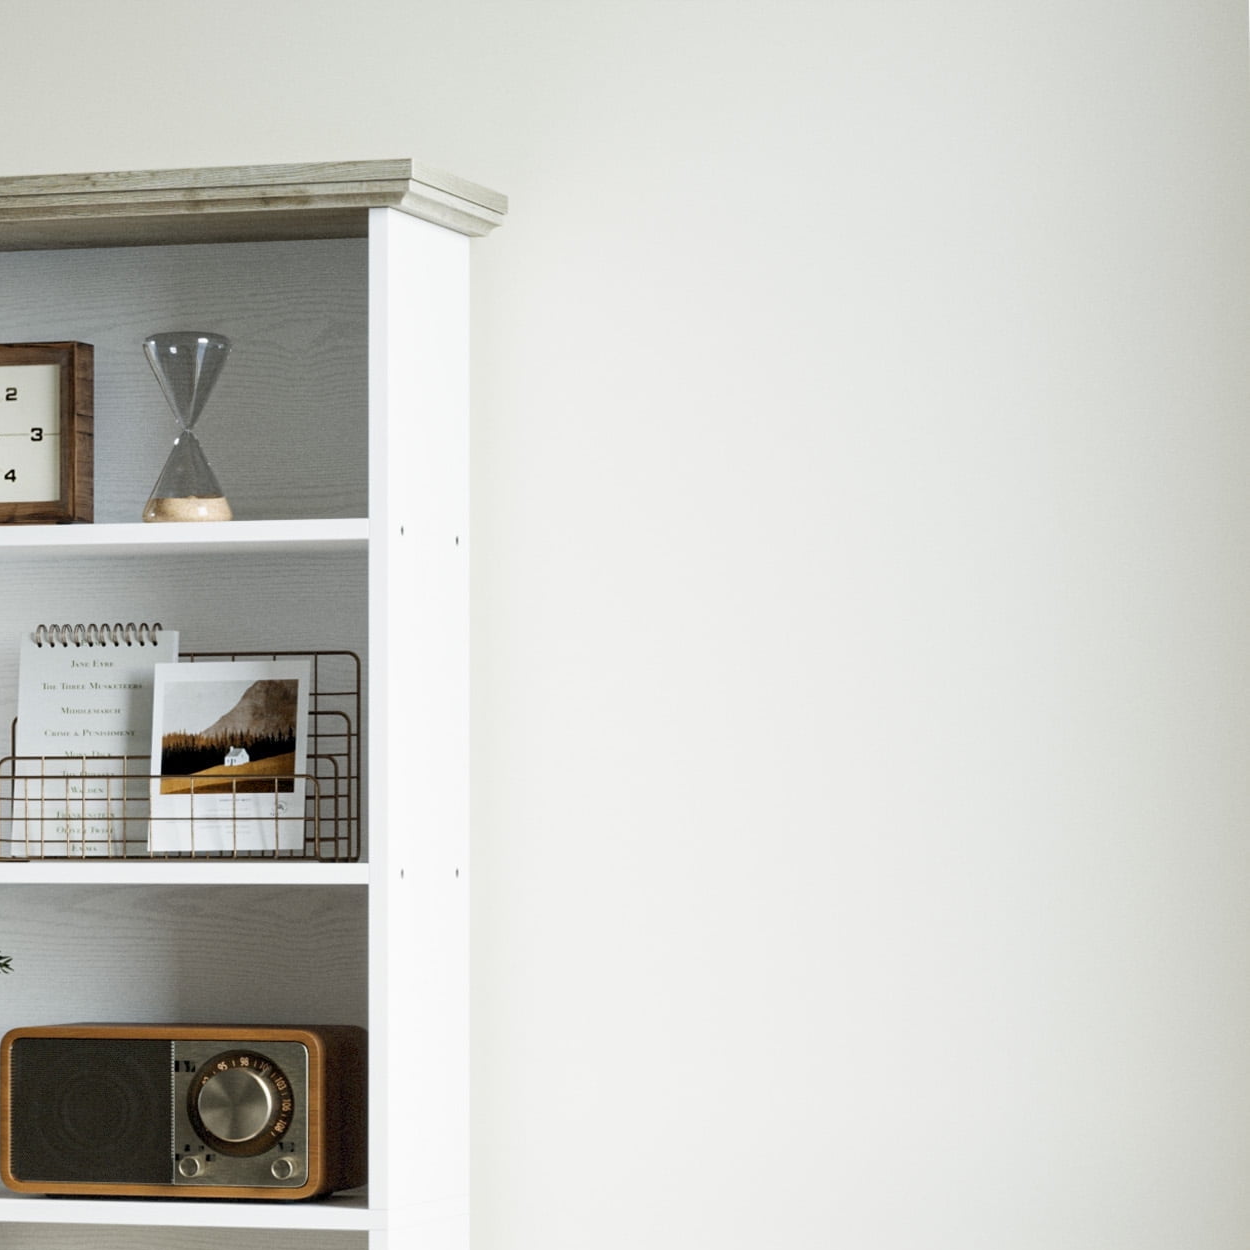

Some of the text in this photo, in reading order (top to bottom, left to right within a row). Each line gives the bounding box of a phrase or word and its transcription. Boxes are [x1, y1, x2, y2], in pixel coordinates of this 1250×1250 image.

[5, 388, 18, 401] 2
[30, 428, 44, 442] 3
[4, 470, 17, 482] 4
[217, 1061, 228, 1070] 95
[240, 1057, 249, 1066] 98
